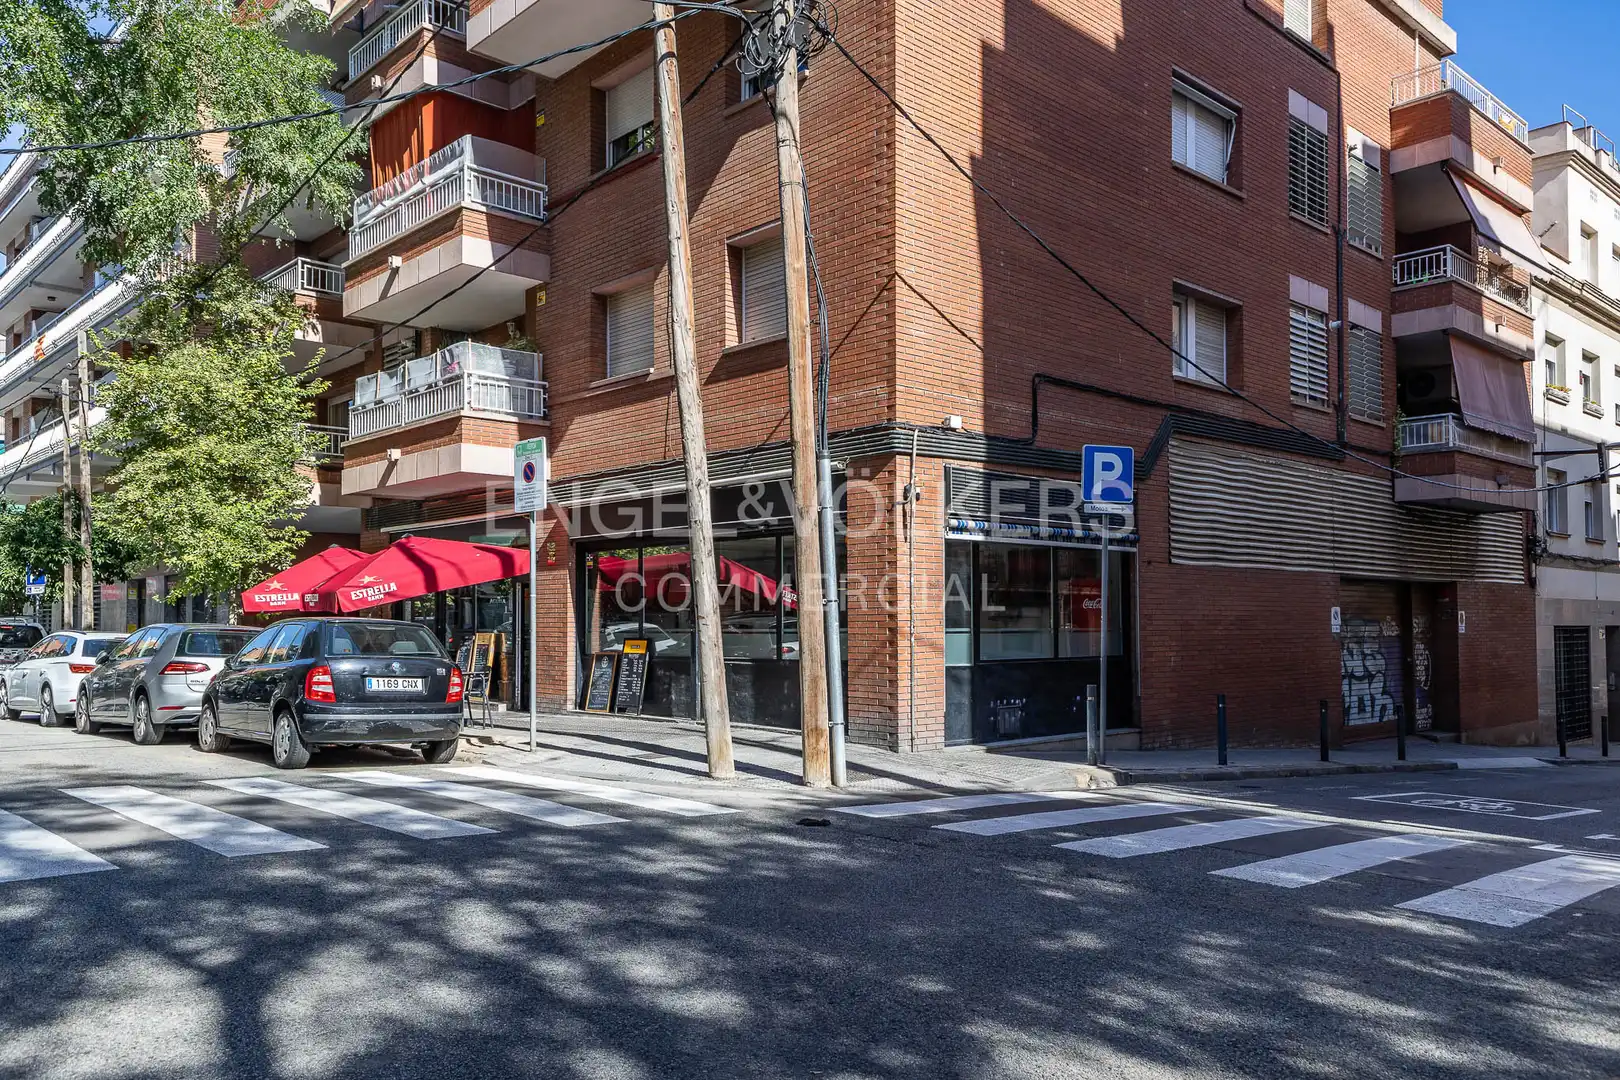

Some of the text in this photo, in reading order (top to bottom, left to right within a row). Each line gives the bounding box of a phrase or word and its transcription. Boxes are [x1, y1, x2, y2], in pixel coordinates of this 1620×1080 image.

[1093, 452, 1124, 500] P
[254, 592, 300, 602] ESTRELLA
[350, 582, 398, 601] ESTRELLA
[375, 679, 419, 689] 1169 CNX
